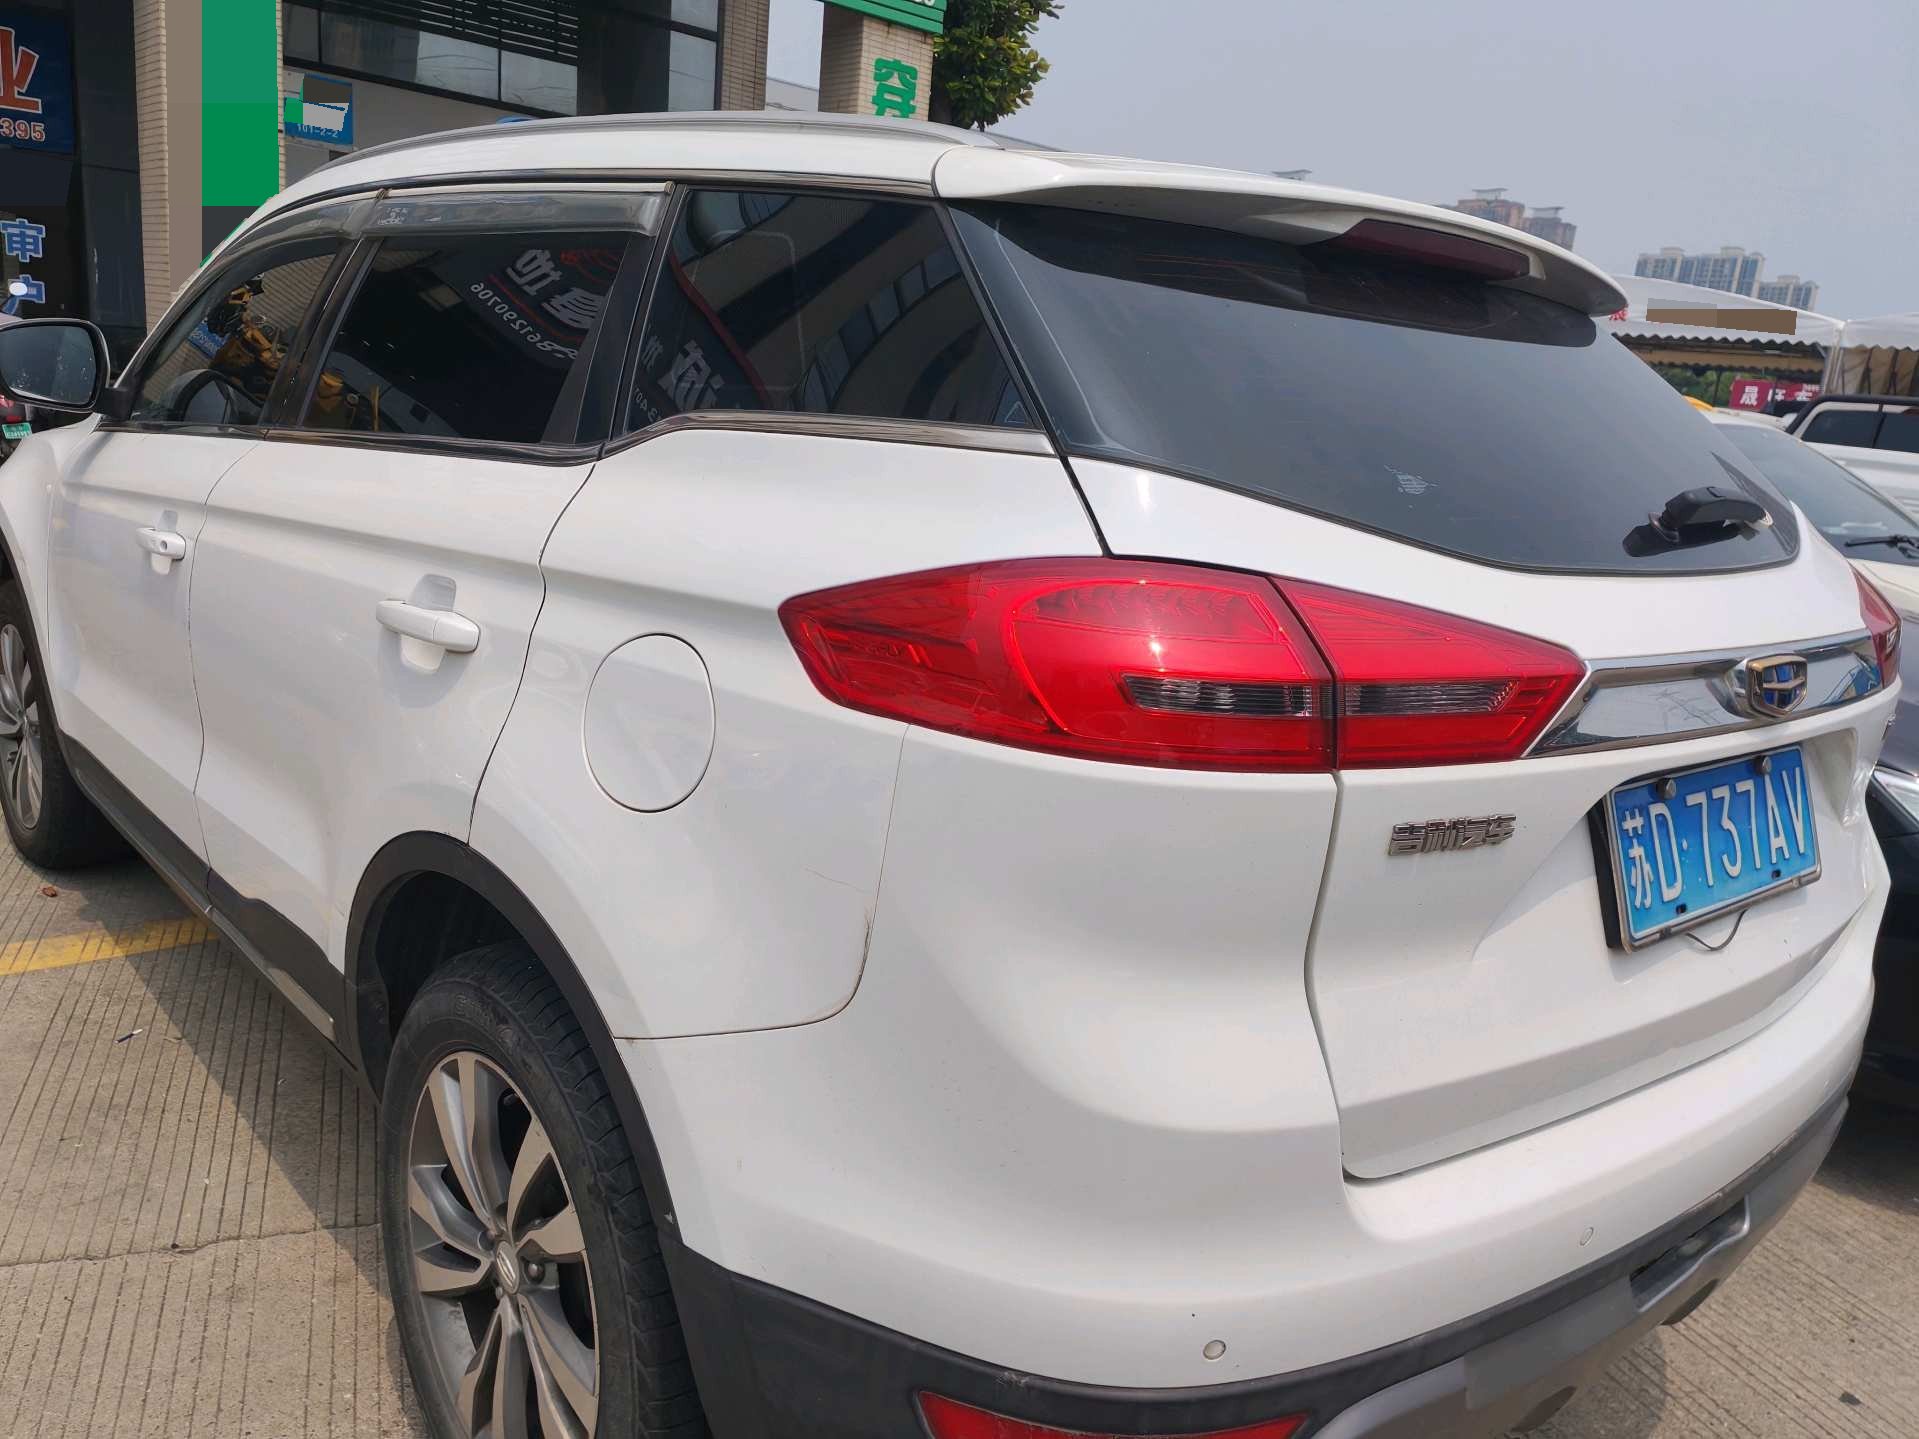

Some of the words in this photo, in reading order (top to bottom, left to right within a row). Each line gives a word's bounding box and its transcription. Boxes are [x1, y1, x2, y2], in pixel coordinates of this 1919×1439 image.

[0, 218, 46, 263] 审
[1388, 813, 1517, 856] 吉利汽车
